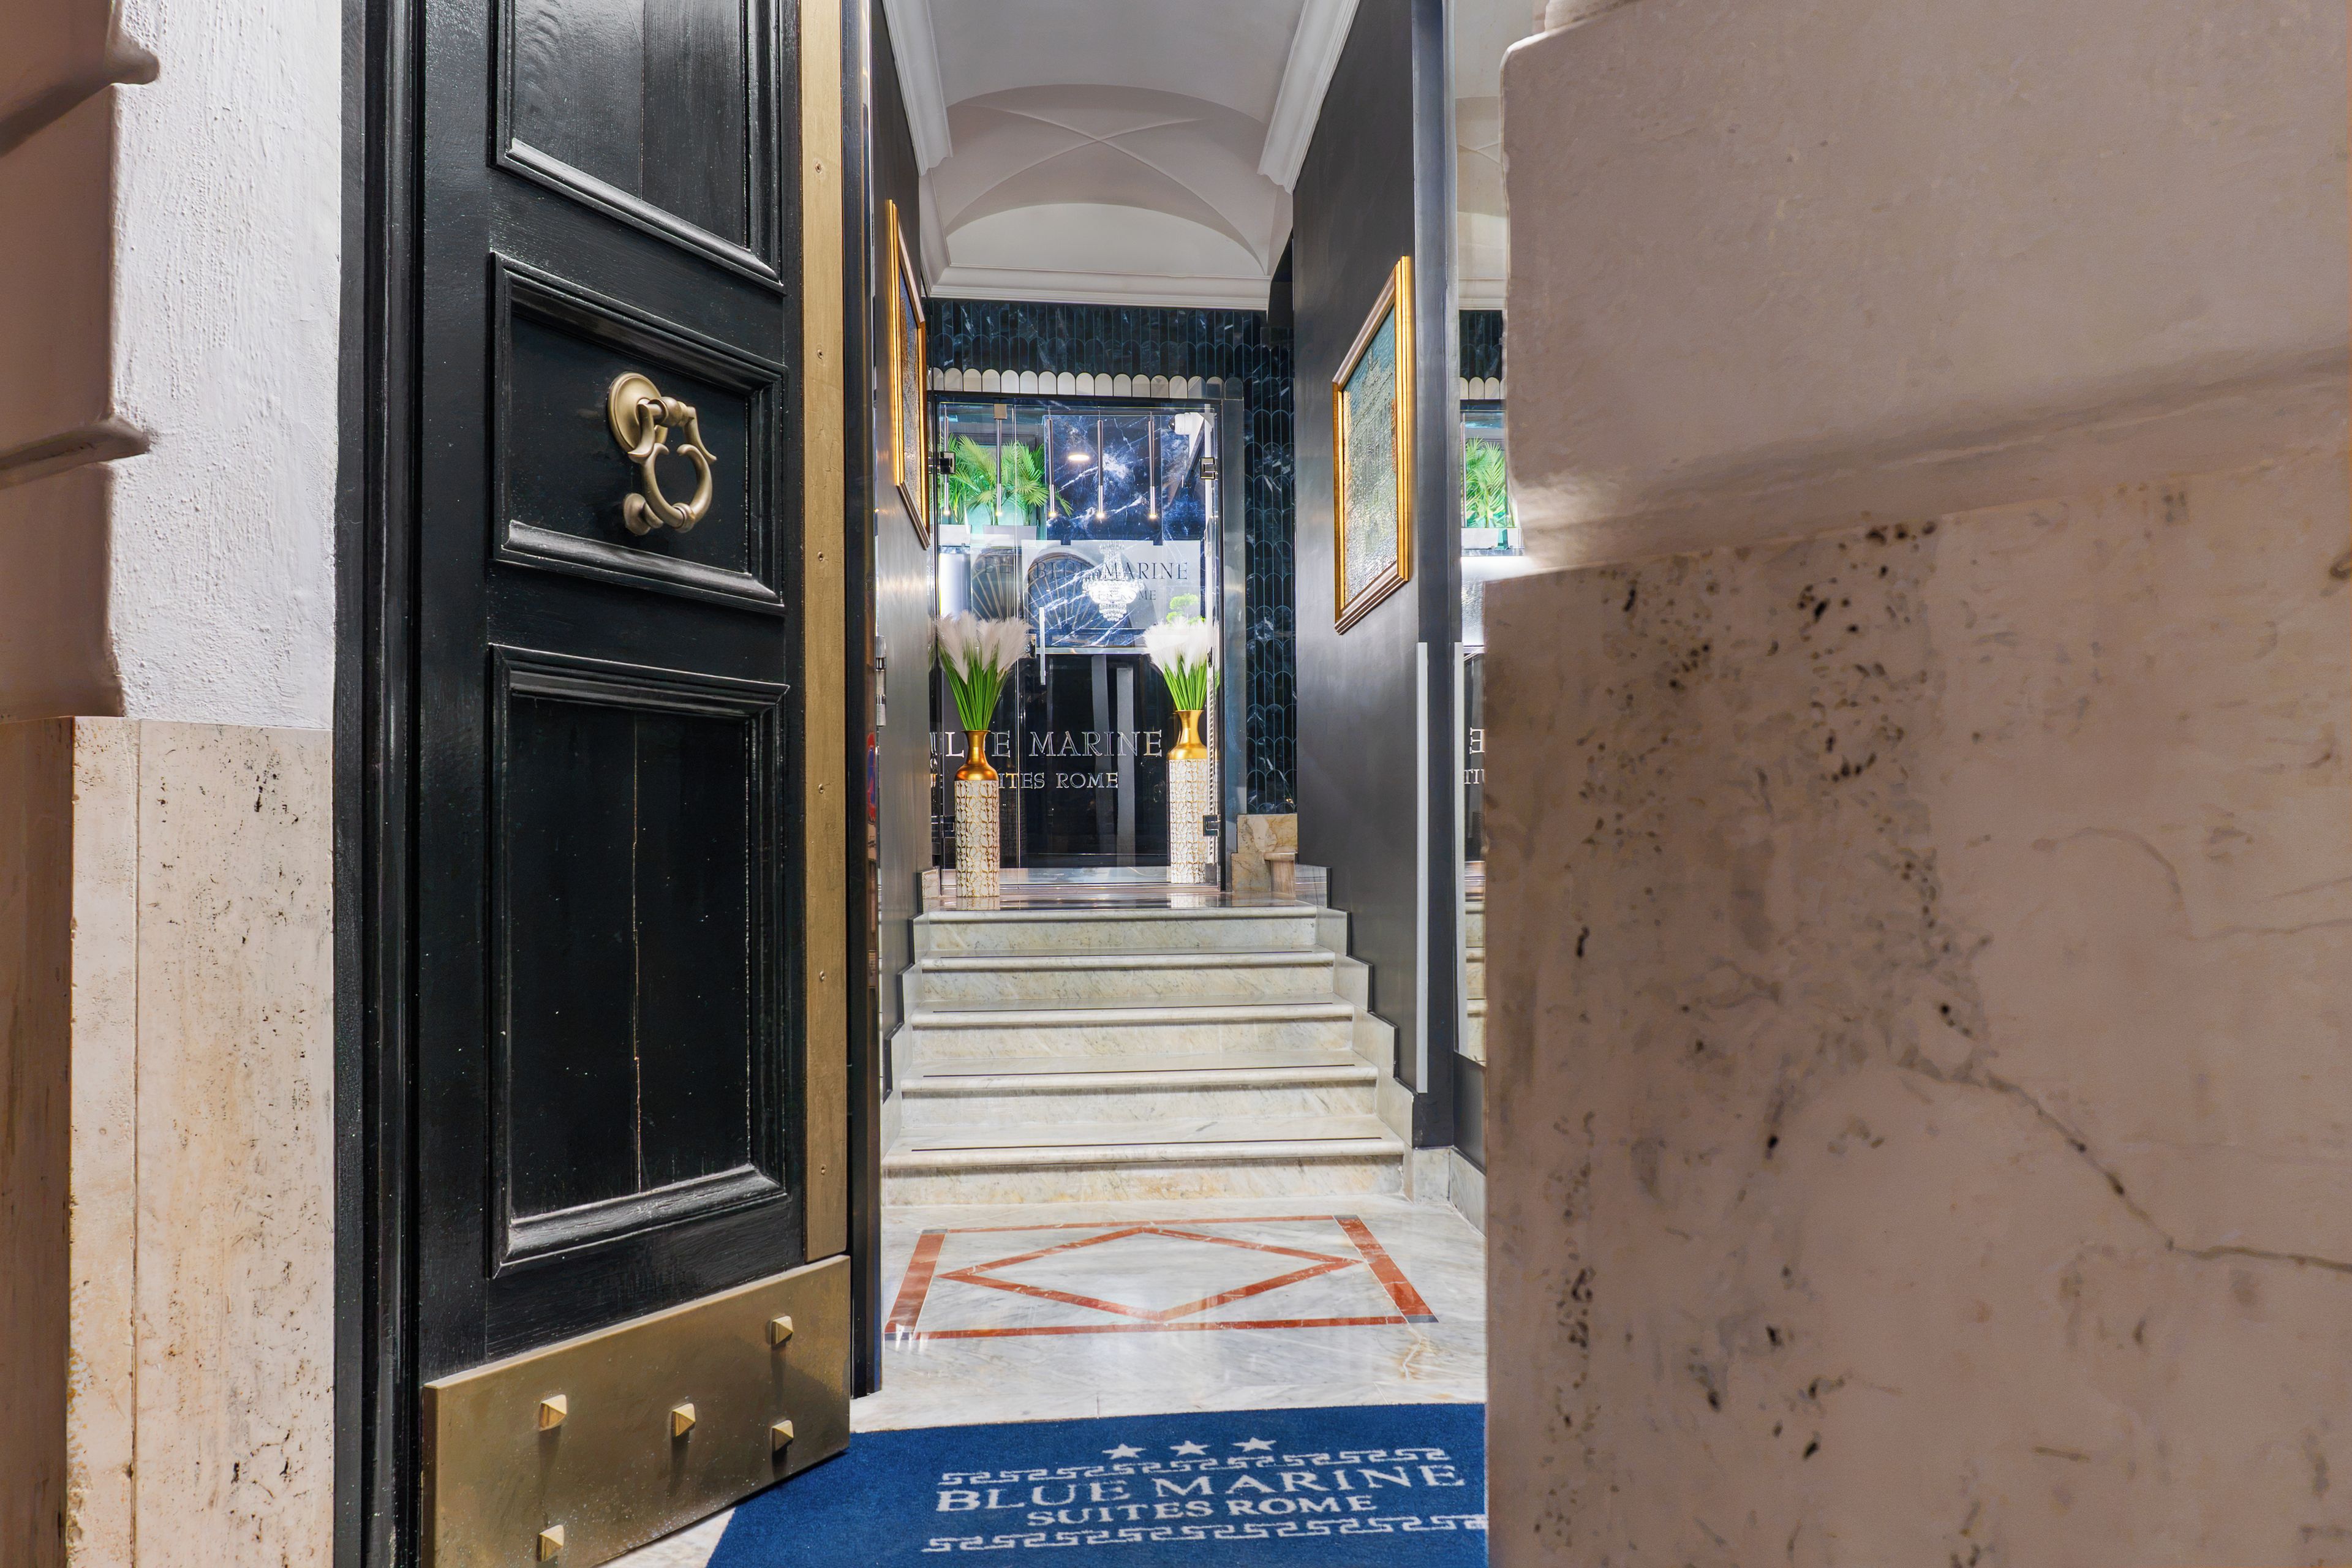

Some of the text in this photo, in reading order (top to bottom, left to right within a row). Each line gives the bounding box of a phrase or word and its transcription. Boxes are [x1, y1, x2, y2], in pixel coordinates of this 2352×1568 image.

[1103, 562, 1188, 579] MARINE
[1028, 729, 1163, 757] MARINE
[1056, 772, 1119, 789] ROME
[936, 1465, 1466, 1512] BLUE MARINE
[1027, 1494, 1378, 1526] SUITES ROME
